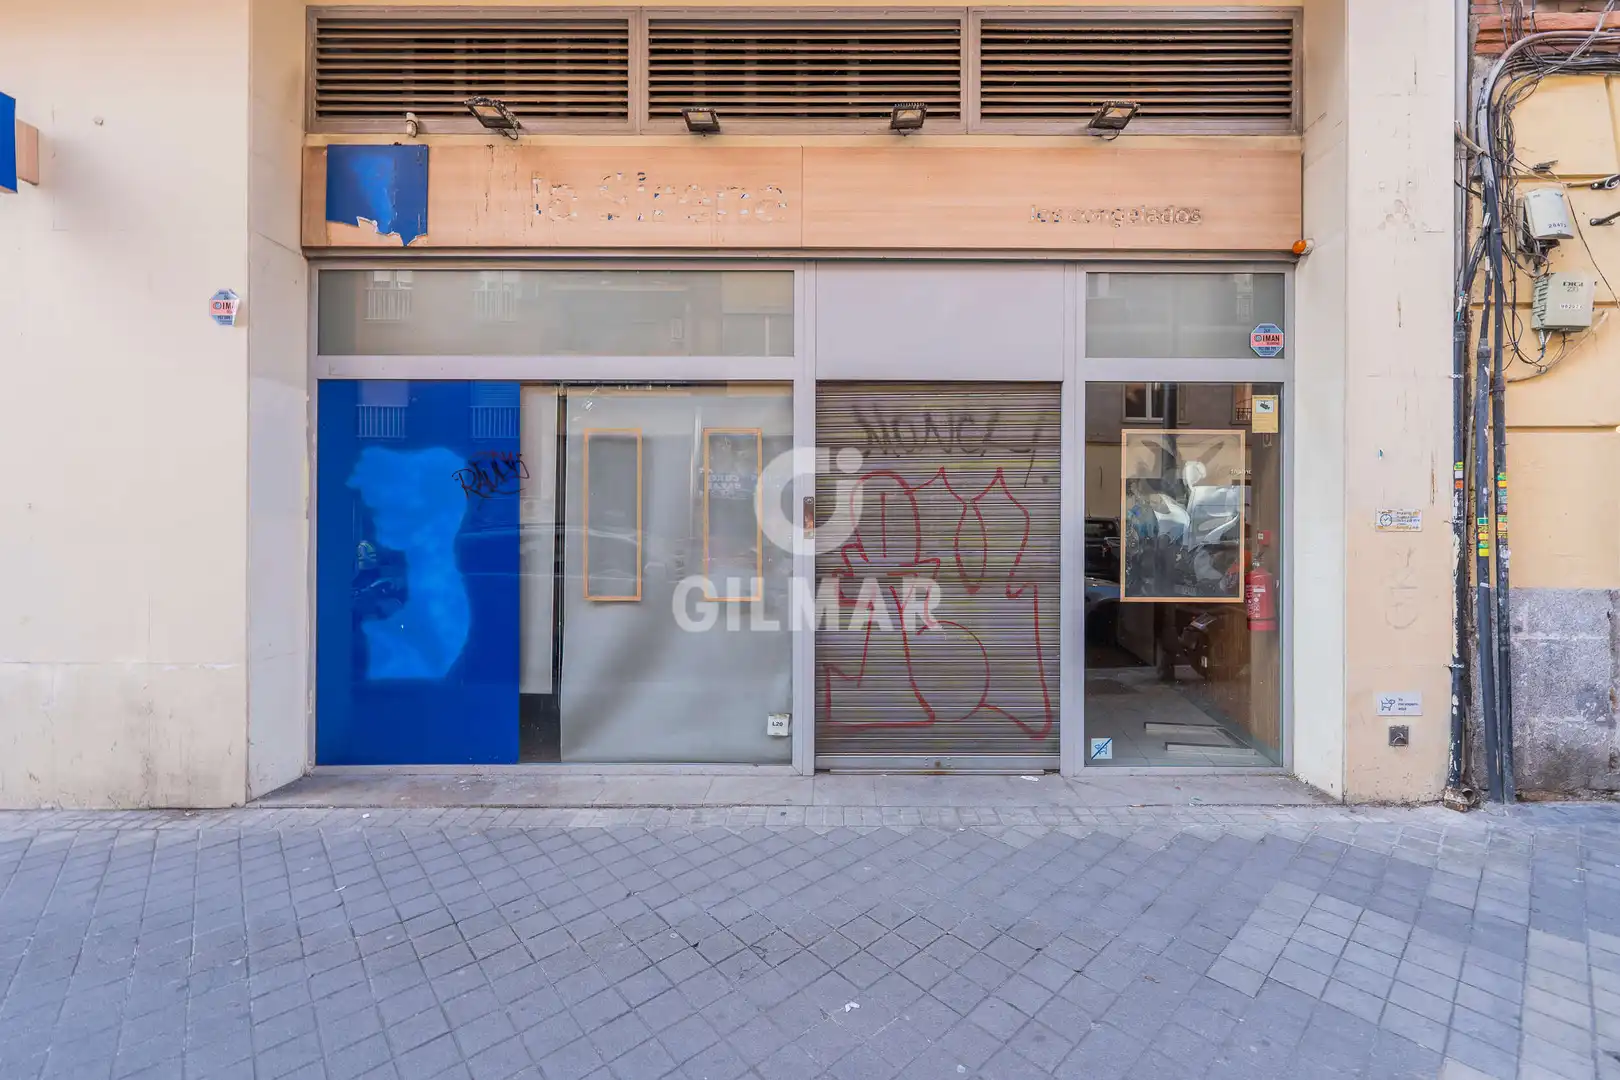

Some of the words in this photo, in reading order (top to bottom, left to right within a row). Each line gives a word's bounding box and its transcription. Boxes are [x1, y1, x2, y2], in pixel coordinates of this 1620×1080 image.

[1030, 205, 1063, 223] los
[1068, 205, 1201, 229] congelados
[1262, 334, 1280, 342] IMAN
